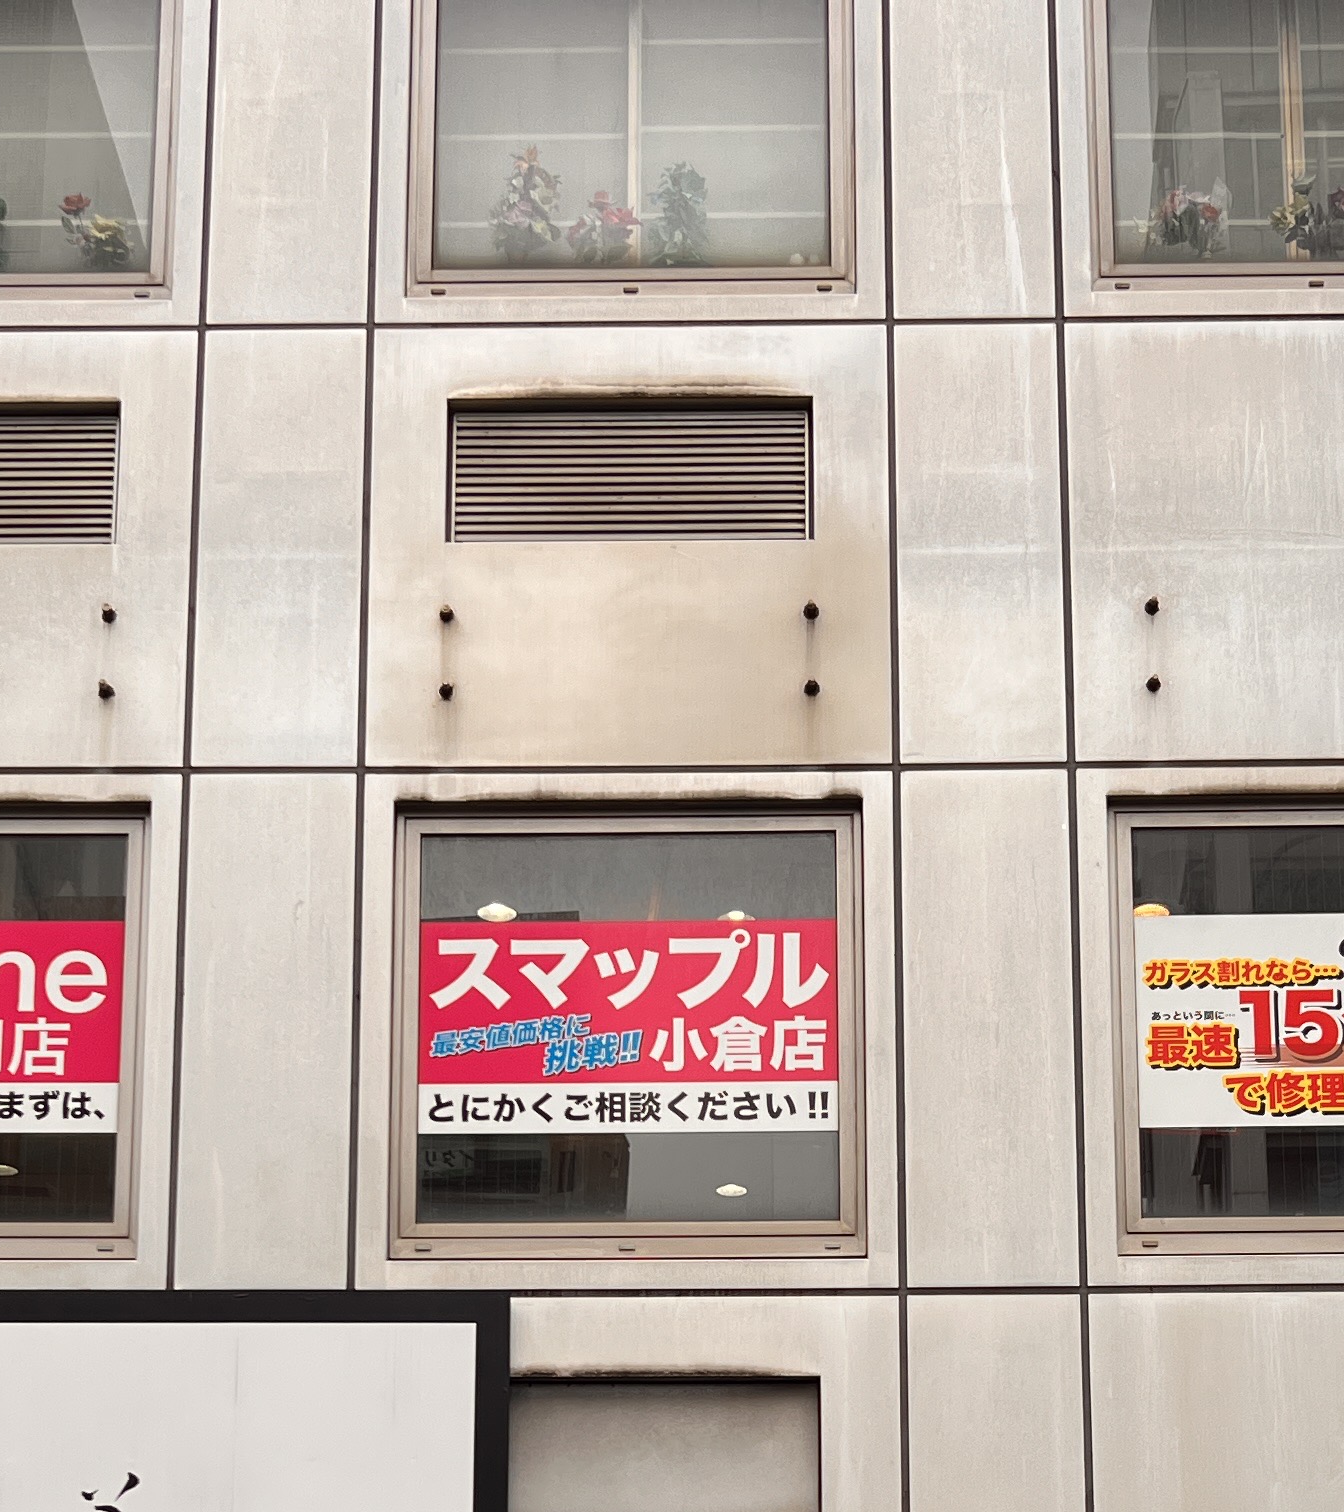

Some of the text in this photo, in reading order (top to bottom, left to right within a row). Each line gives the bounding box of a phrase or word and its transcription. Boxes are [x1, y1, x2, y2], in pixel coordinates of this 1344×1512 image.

[429, 929, 830, 1010] スマップル
[430, 1013, 592, 1057] 最安値価格に
[542, 1030, 643, 1077] 挑戦!!
[649, 1015, 828, 1072] 小倉店
[1146, 1024, 1238, 1068] 最速
